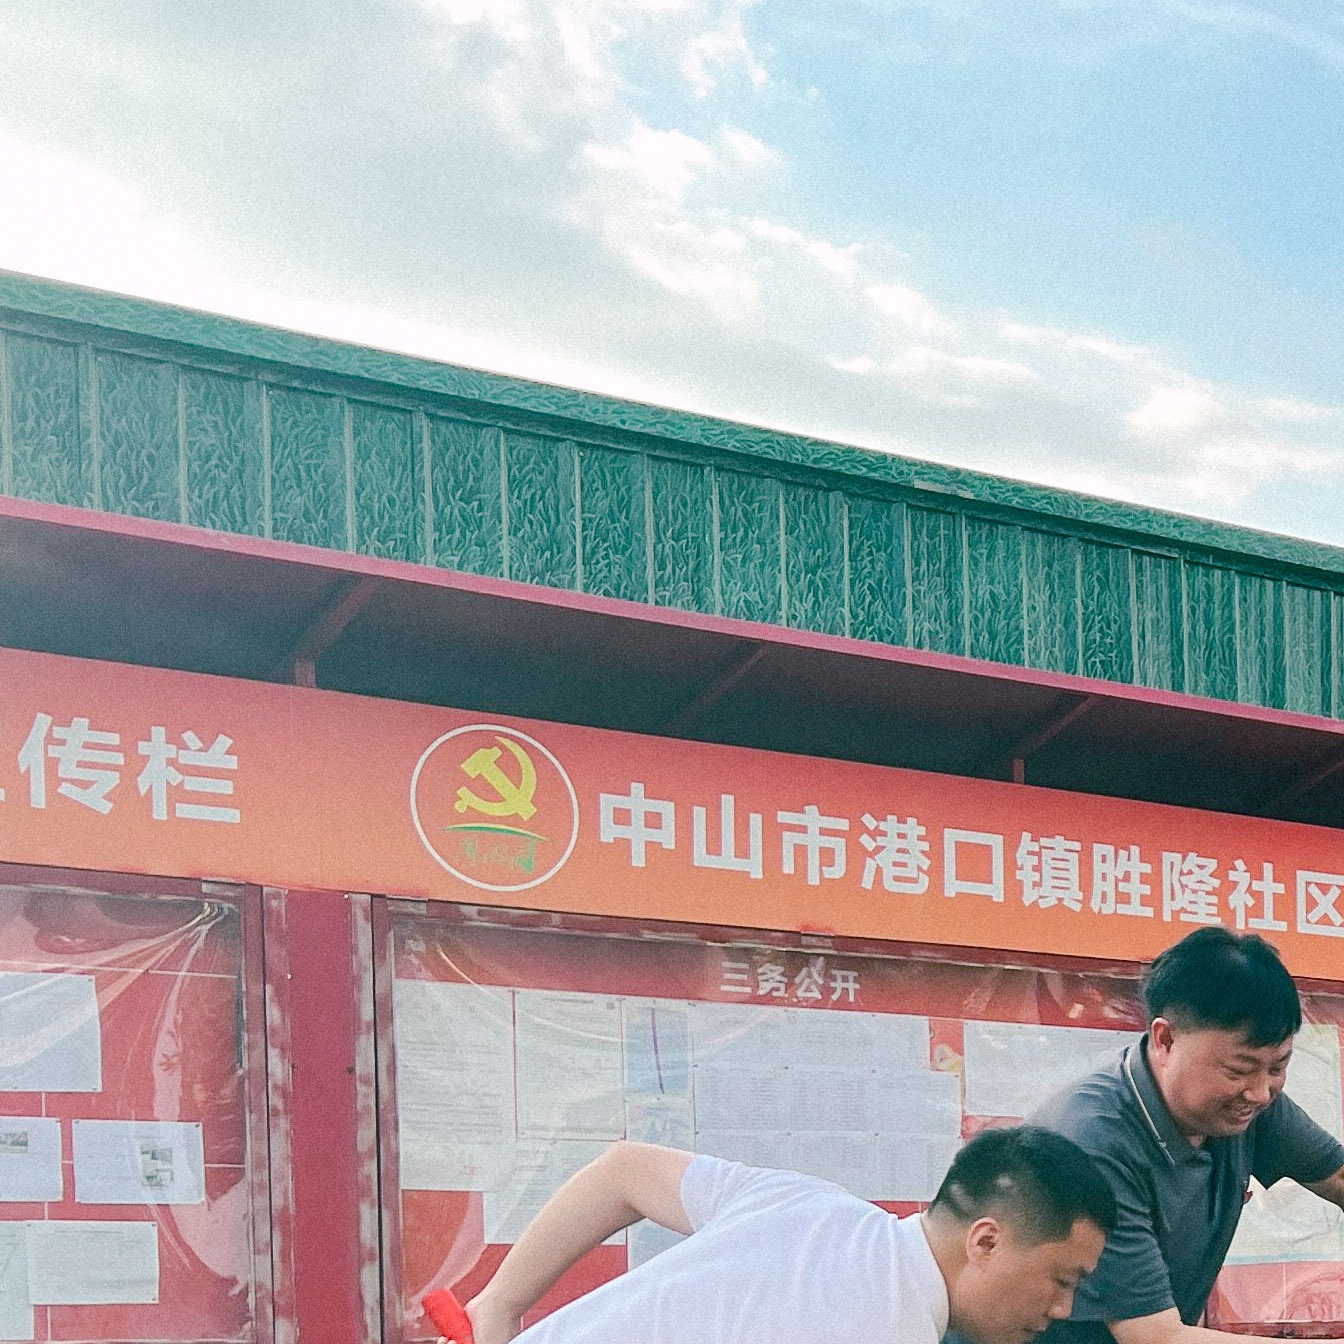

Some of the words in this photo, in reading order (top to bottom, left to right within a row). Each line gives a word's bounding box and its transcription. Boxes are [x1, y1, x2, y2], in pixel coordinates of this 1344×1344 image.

[0, 712, 241, 823] 传栏
[720, 961, 861, 1002] 三务公开
